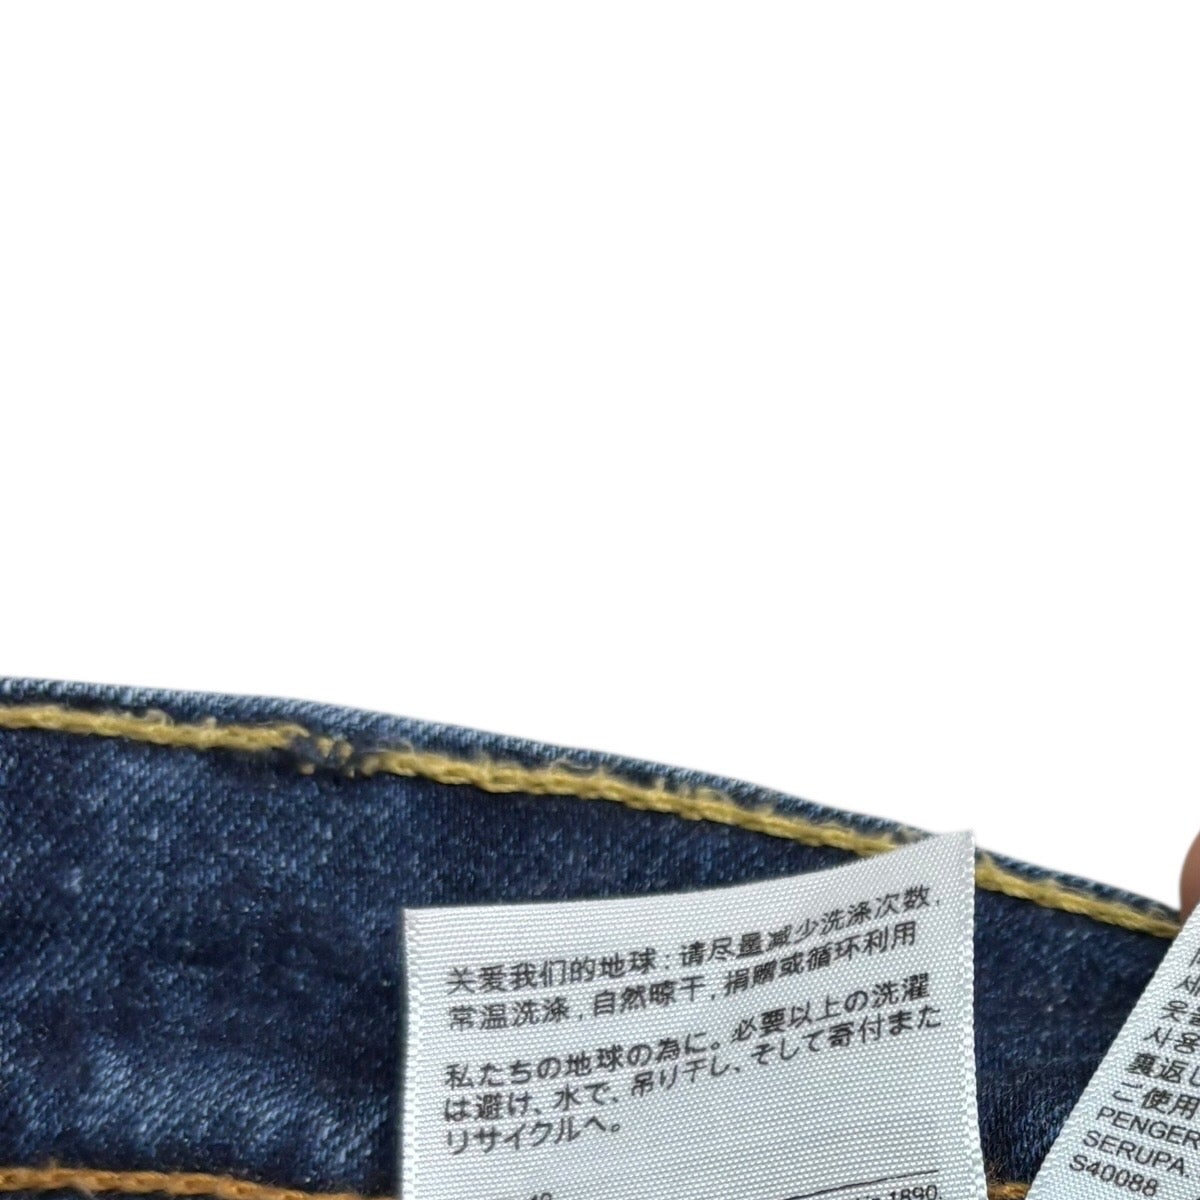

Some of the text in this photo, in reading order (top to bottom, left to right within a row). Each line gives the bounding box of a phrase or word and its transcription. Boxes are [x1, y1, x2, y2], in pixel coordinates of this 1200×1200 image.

[447, 1115, 621, 1155] リサイクルへ。
[1082, 1130, 1190, 1179] SERUPA.
[1069, 1154, 1160, 1197] S40088
